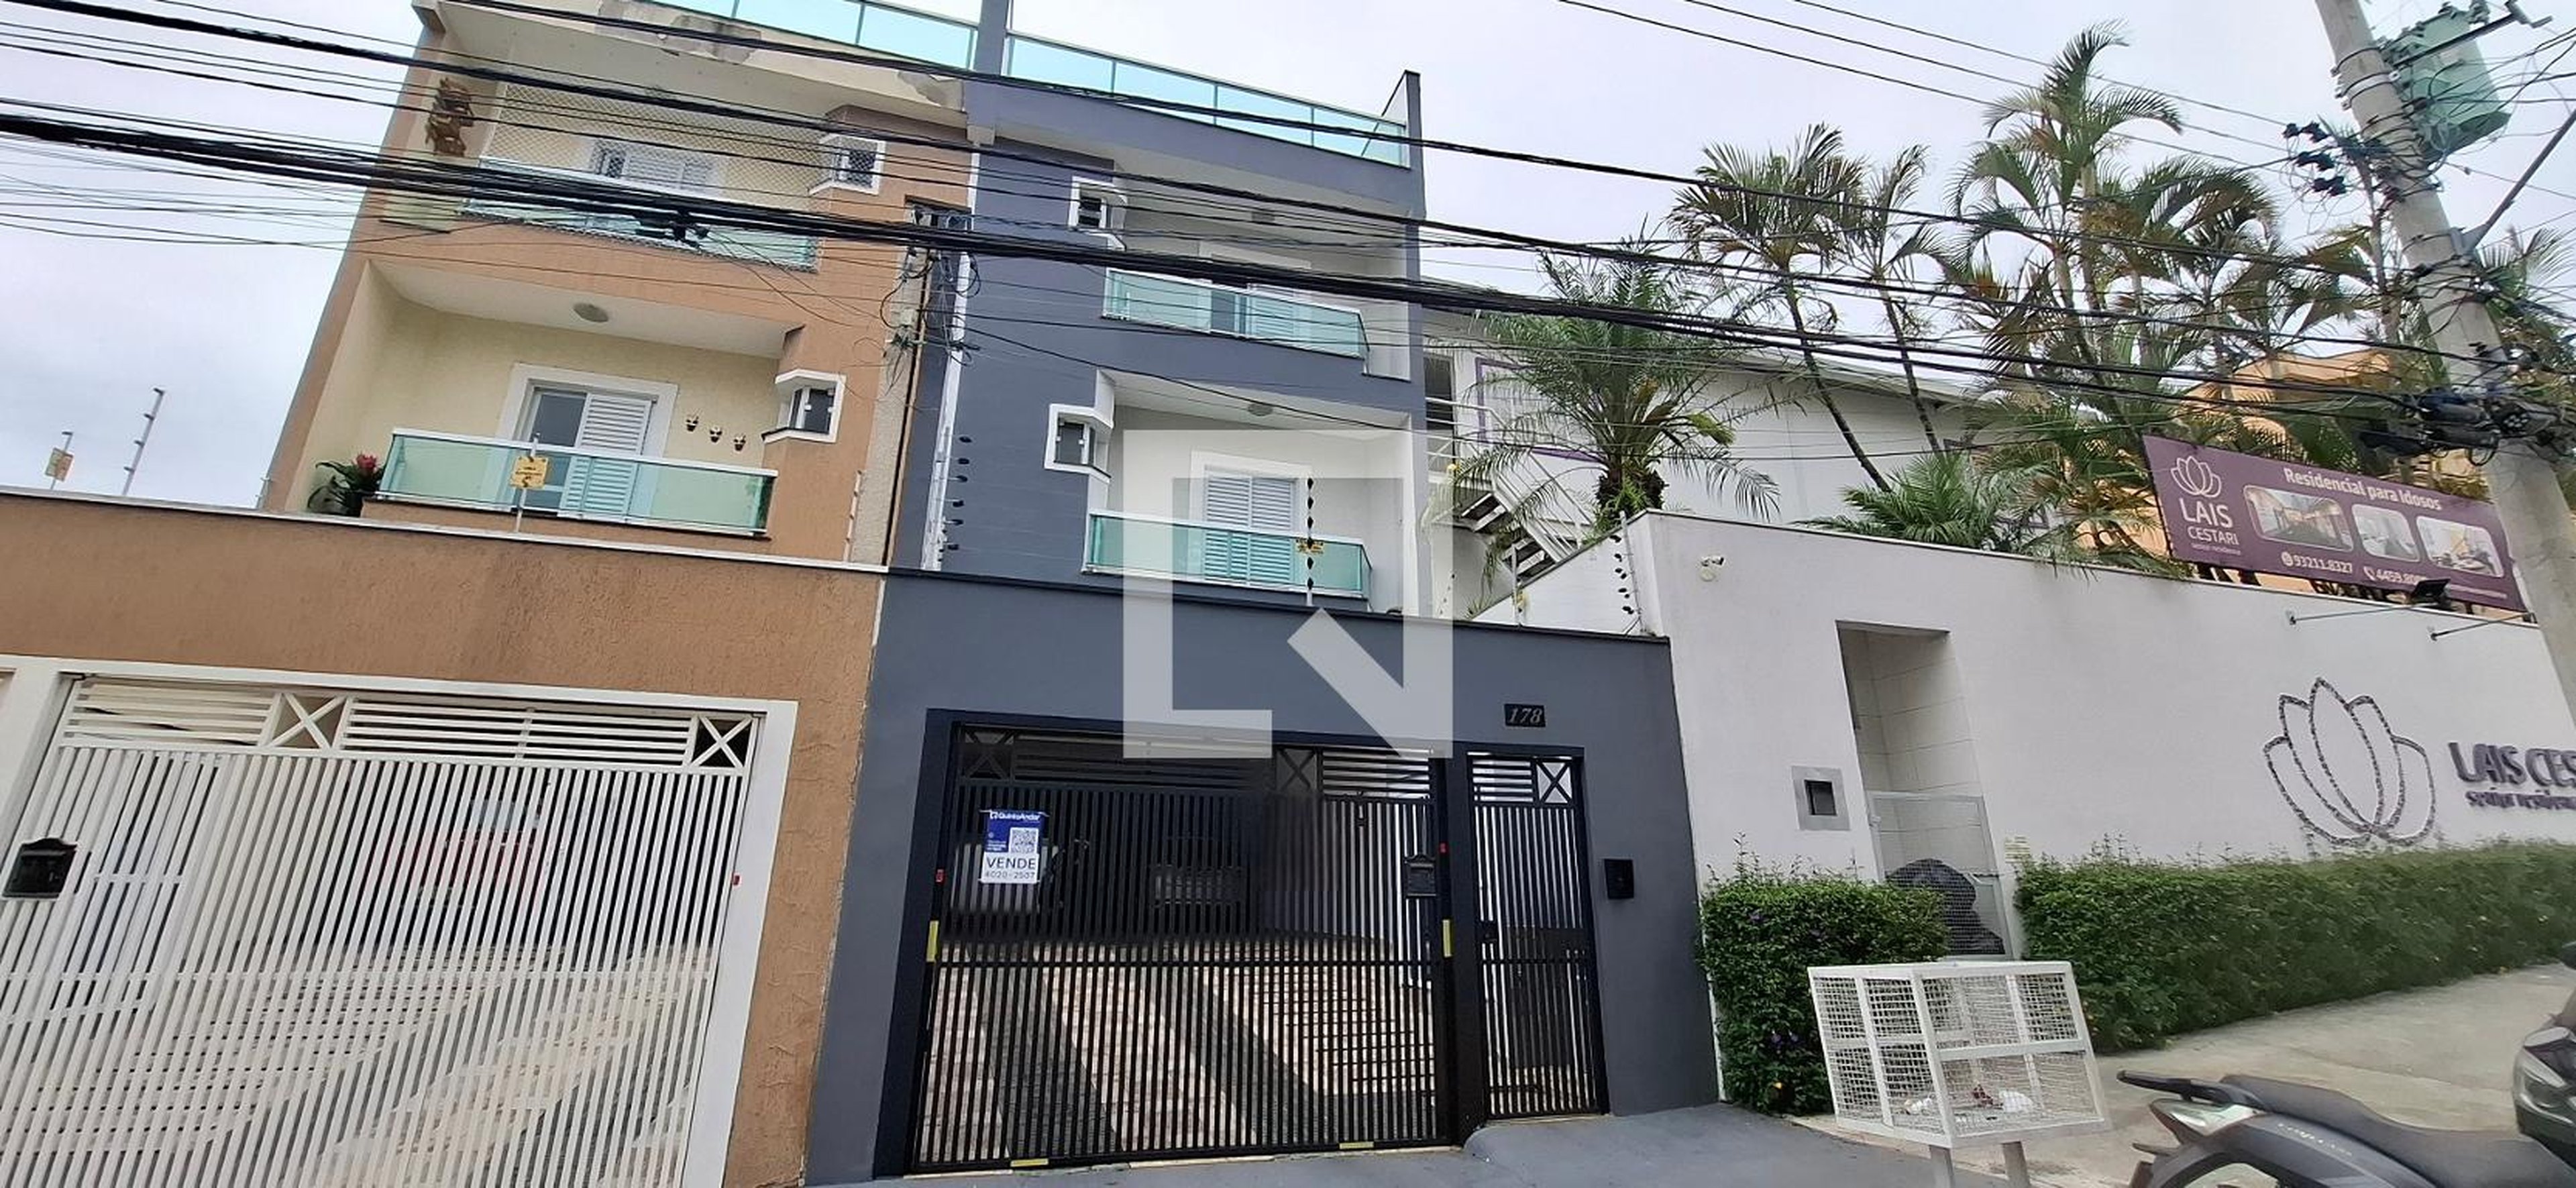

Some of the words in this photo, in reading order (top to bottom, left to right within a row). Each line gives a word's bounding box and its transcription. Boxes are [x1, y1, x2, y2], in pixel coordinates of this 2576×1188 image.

[2283, 468, 2366, 496] Residencial
[2366, 485, 2399, 502] para
[2399, 490, 2443, 510] Idosos
[2179, 498, 2233, 528] LAIS
[2188, 526, 2240, 545] CESTARI
[1509, 708, 1543, 724] 178
[2447, 742, 2528, 785] LAIS
[986, 857, 1036, 870] VENDE
